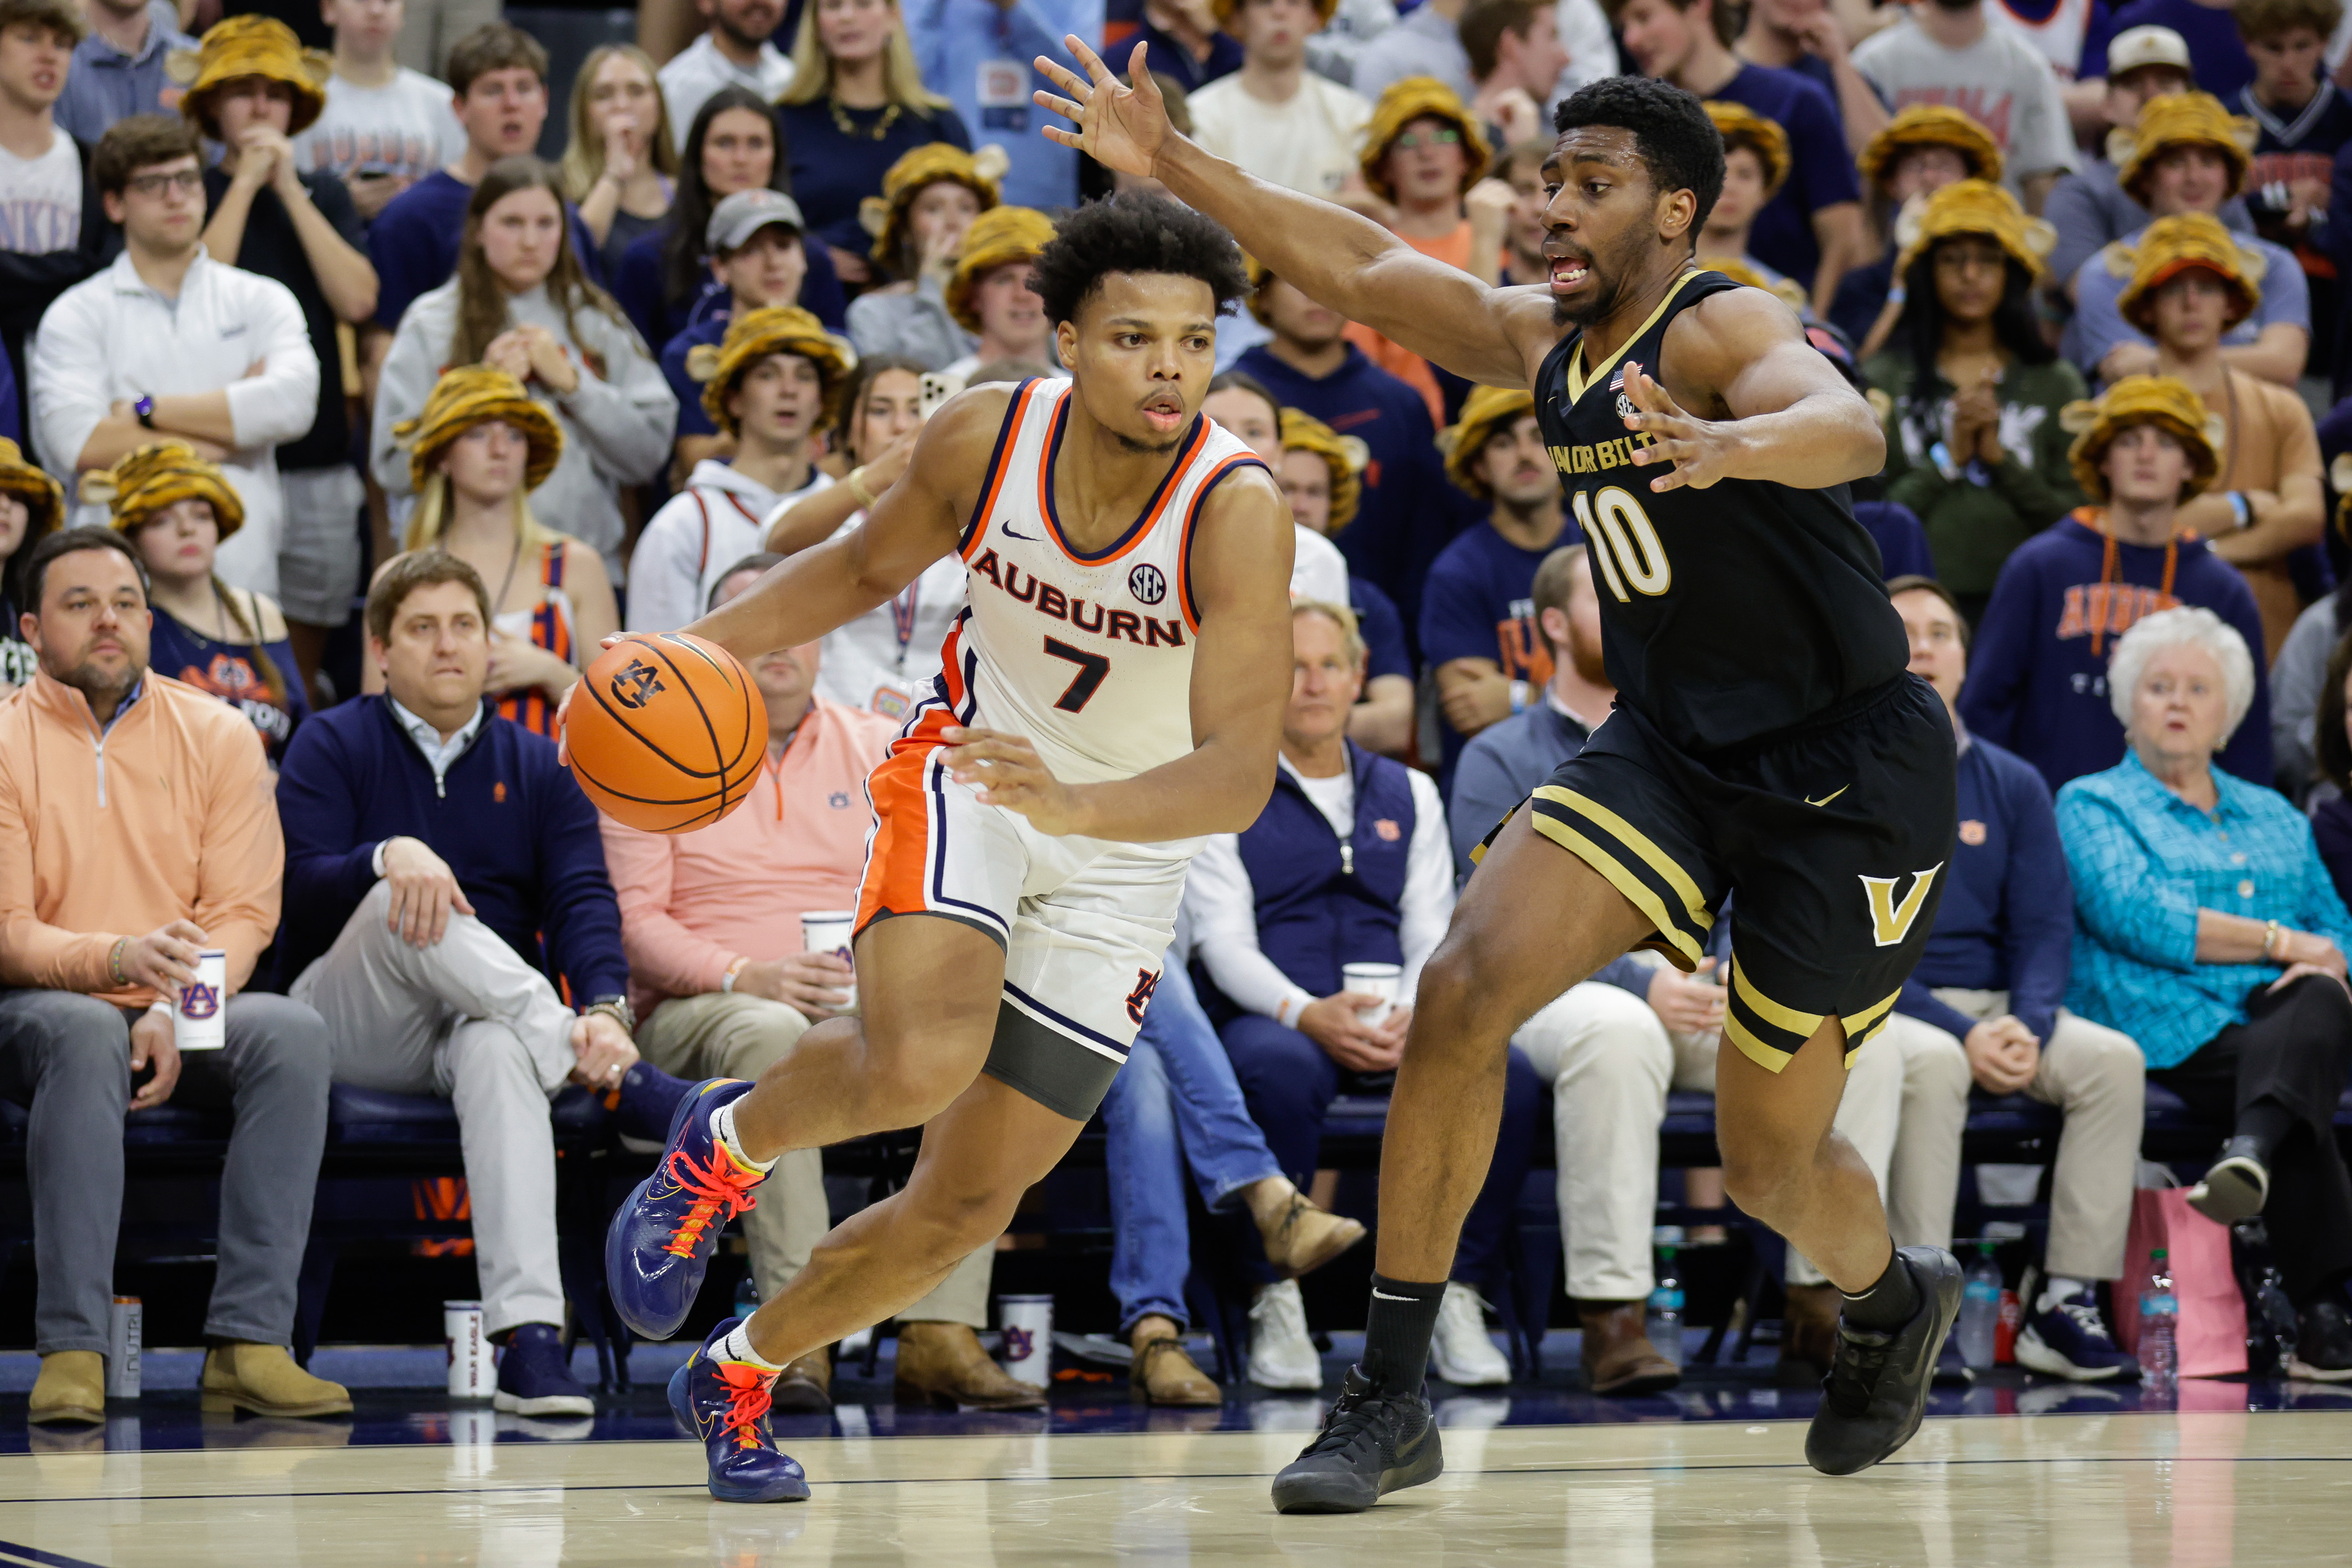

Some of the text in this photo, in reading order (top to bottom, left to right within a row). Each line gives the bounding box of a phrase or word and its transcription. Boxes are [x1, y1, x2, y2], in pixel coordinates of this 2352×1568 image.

[1616, 393, 1634, 418] SEC
[1131, 565, 1164, 603] SEC
[1572, 485, 1671, 603] 10
[971, 546, 1186, 648] AUBURN
[1043, 634, 1110, 714] 7
[1858, 860, 1944, 947] V
